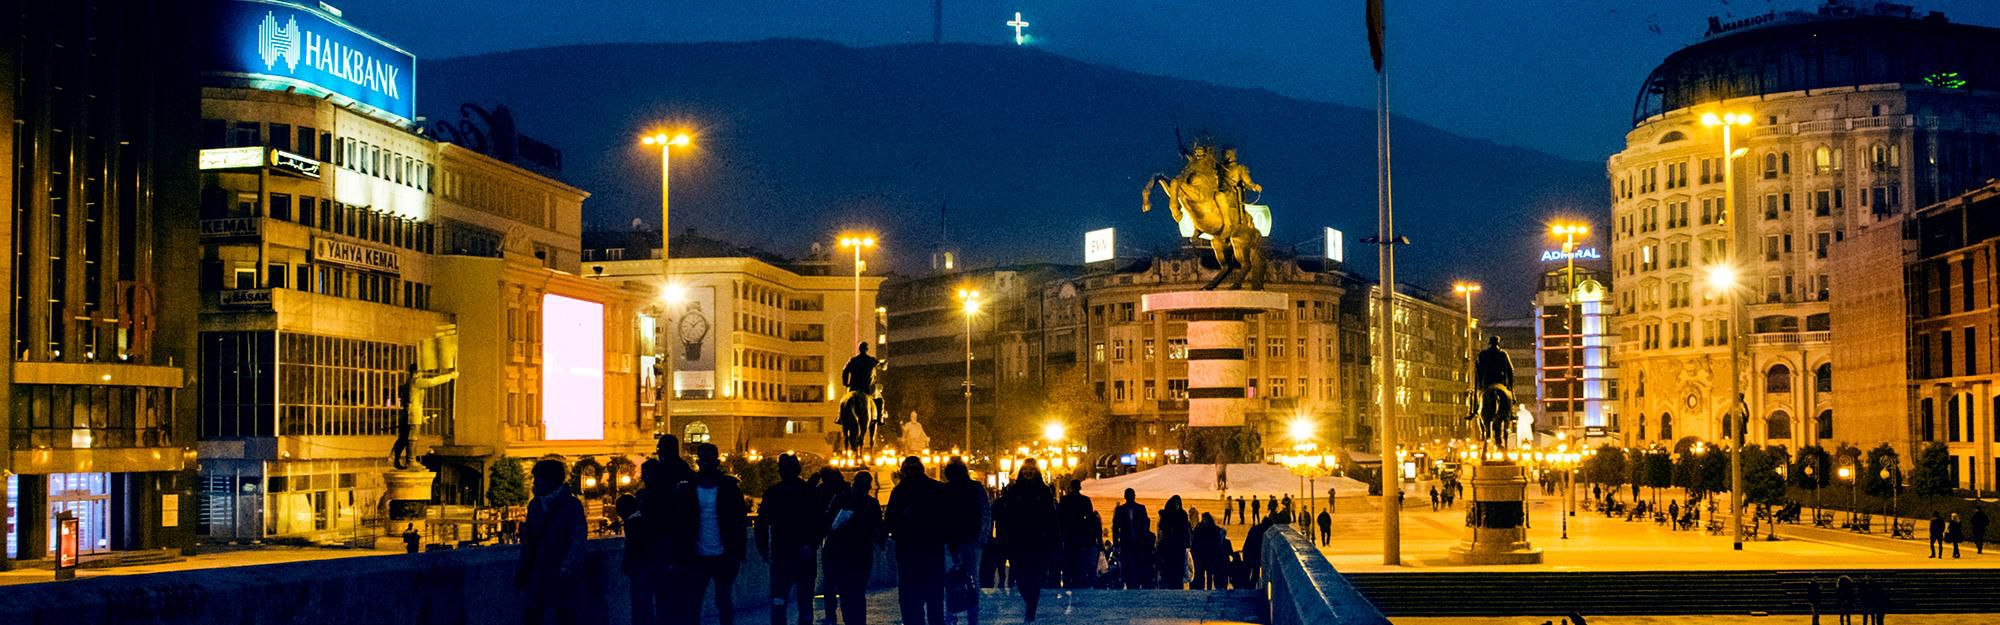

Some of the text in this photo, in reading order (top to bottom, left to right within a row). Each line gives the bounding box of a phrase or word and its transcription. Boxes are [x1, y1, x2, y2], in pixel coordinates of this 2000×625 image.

[305, 30, 399, 100] HALKBANK
[328, 240, 399, 270] YAHYA KEMAL
